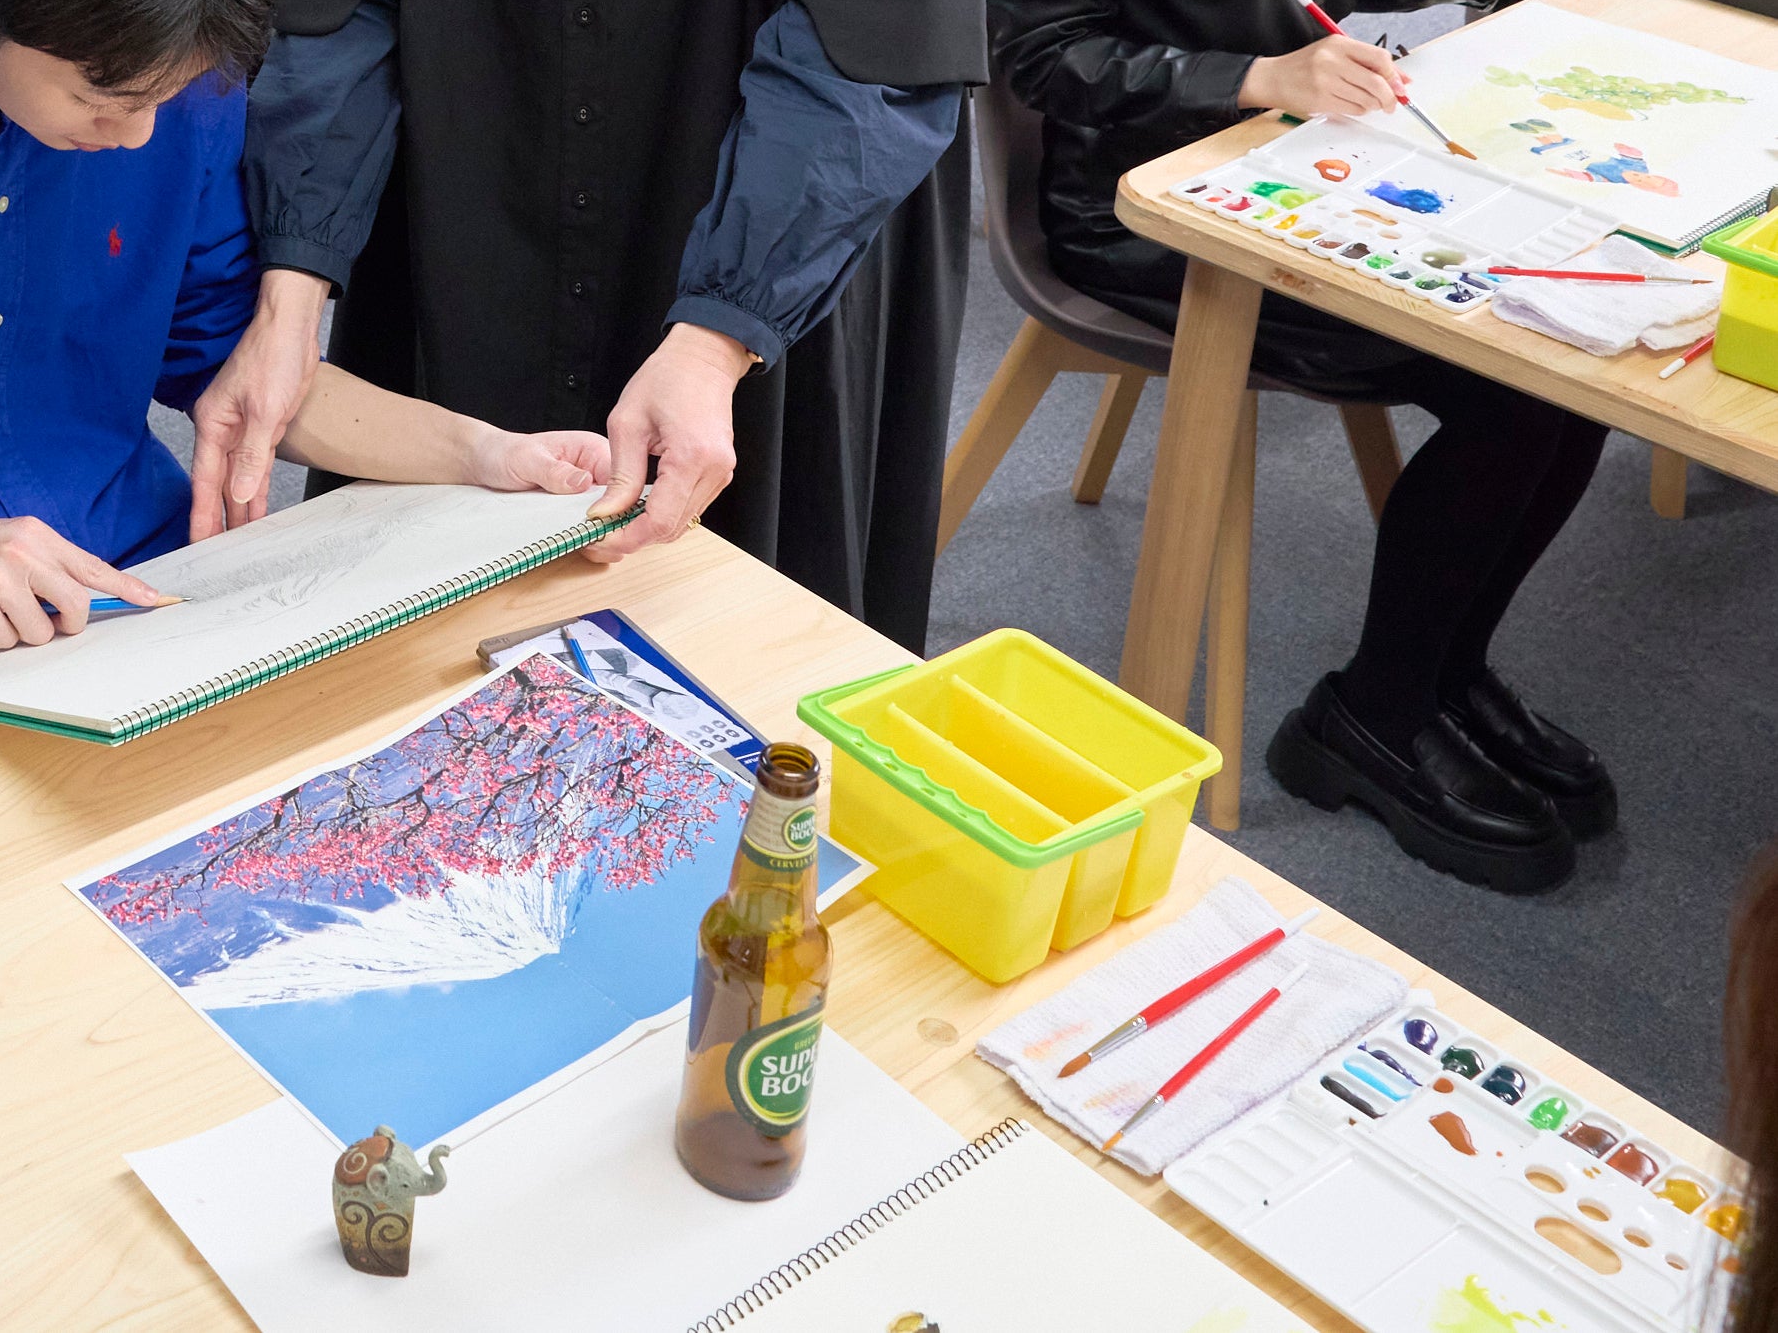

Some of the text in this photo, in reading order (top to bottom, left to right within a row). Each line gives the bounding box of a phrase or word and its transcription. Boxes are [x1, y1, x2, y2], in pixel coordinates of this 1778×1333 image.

[790, 815, 815, 831] SUPE
[760, 1042, 818, 1076] SUPE
[761, 1063, 816, 1097] BOC
